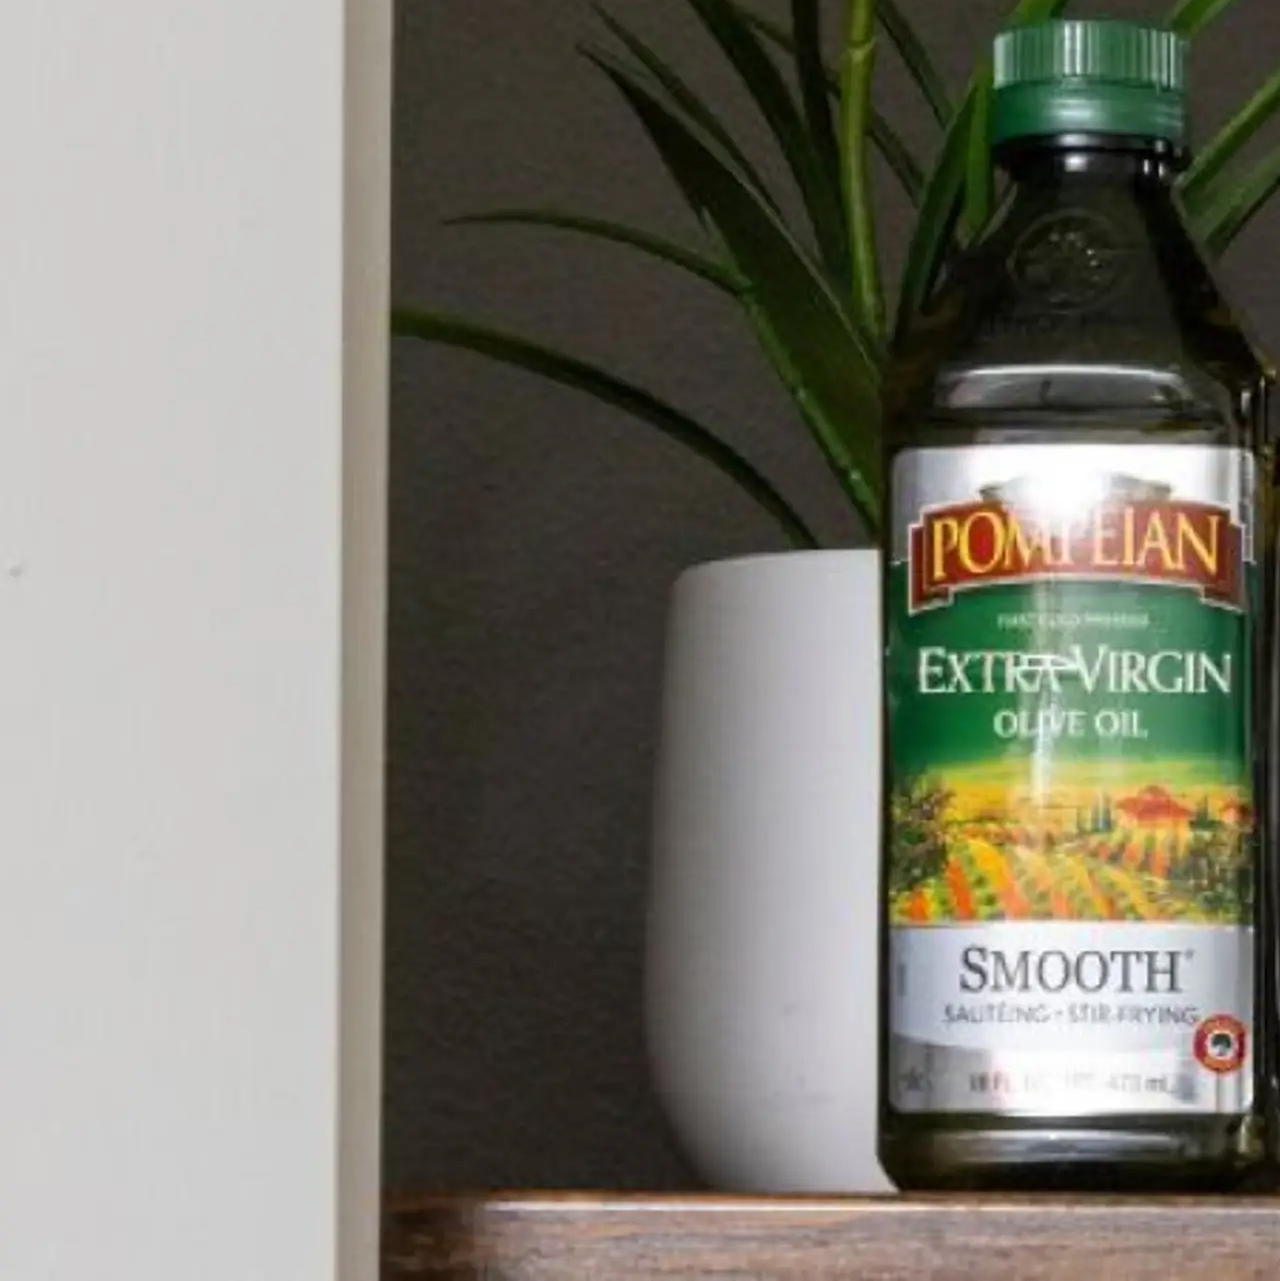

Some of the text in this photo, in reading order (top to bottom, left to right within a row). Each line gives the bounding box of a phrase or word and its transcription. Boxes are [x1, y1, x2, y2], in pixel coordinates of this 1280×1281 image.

[918, 642, 1232, 694] EXTRA VIRGIN
[993, 710, 1149, 740] OLIVE OIL
[958, 944, 1184, 994] SMOOTH
